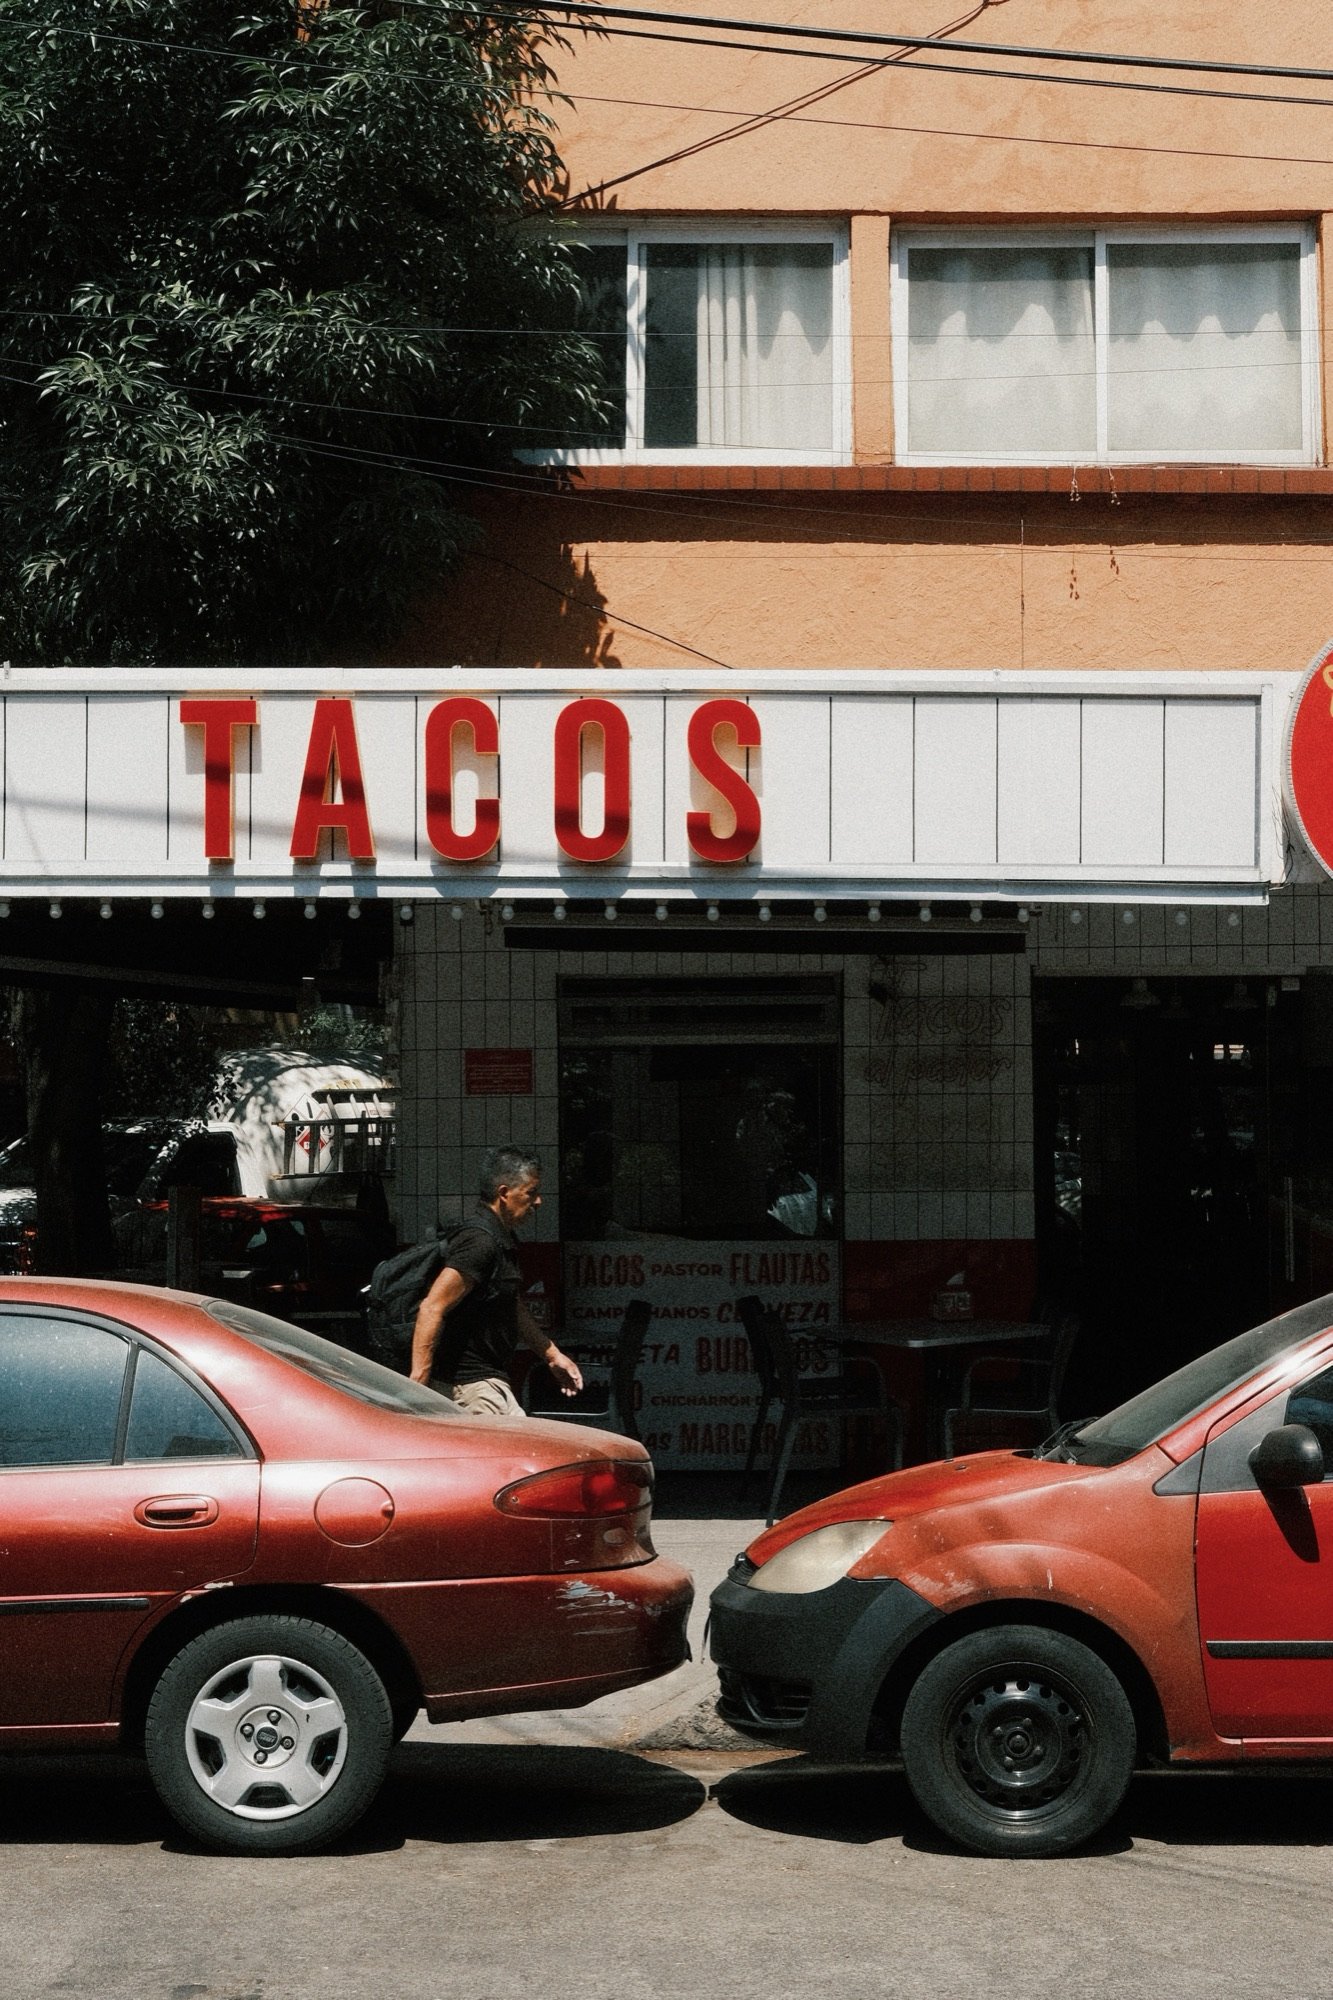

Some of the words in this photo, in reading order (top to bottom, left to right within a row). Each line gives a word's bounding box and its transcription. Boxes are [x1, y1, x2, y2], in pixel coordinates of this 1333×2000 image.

[179, 697, 762, 863] TACOS
[571, 1253, 645, 1288] TACOS
[651, 1263, 723, 1277] PASTOR
[730, 1252, 830, 1285] FLAUTAS
[571, 1306, 711, 1320] CAMPHANOS
[697, 1336, 830, 1373] BUROS
[680, 1422, 830, 1456] MARGRAS
